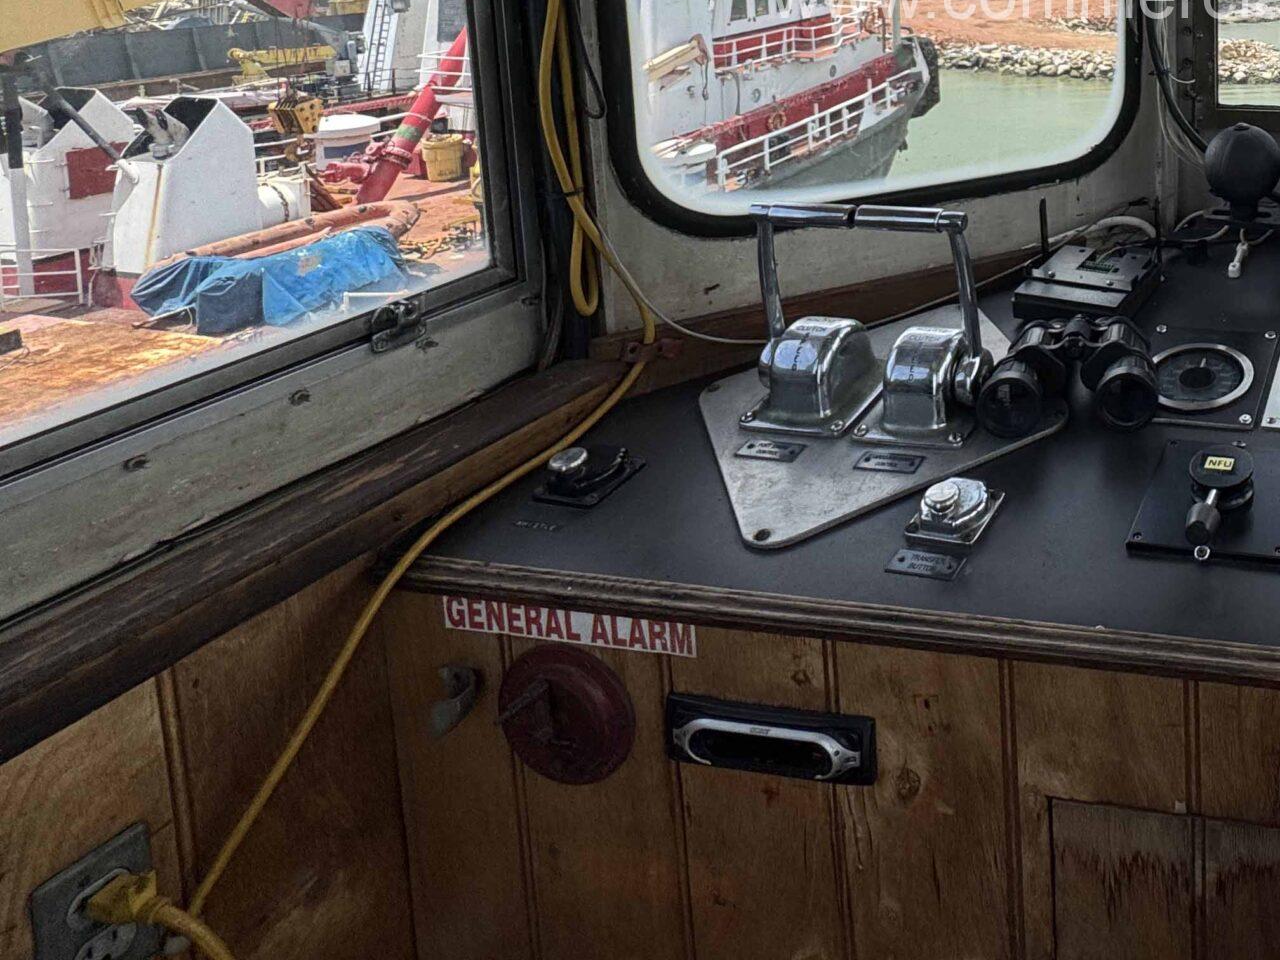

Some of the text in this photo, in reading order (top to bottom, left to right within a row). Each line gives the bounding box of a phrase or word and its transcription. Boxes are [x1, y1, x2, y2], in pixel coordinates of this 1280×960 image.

[1208, 459, 1232, 468] NFU
[446, 596, 694, 656] GENERAL ALARM
